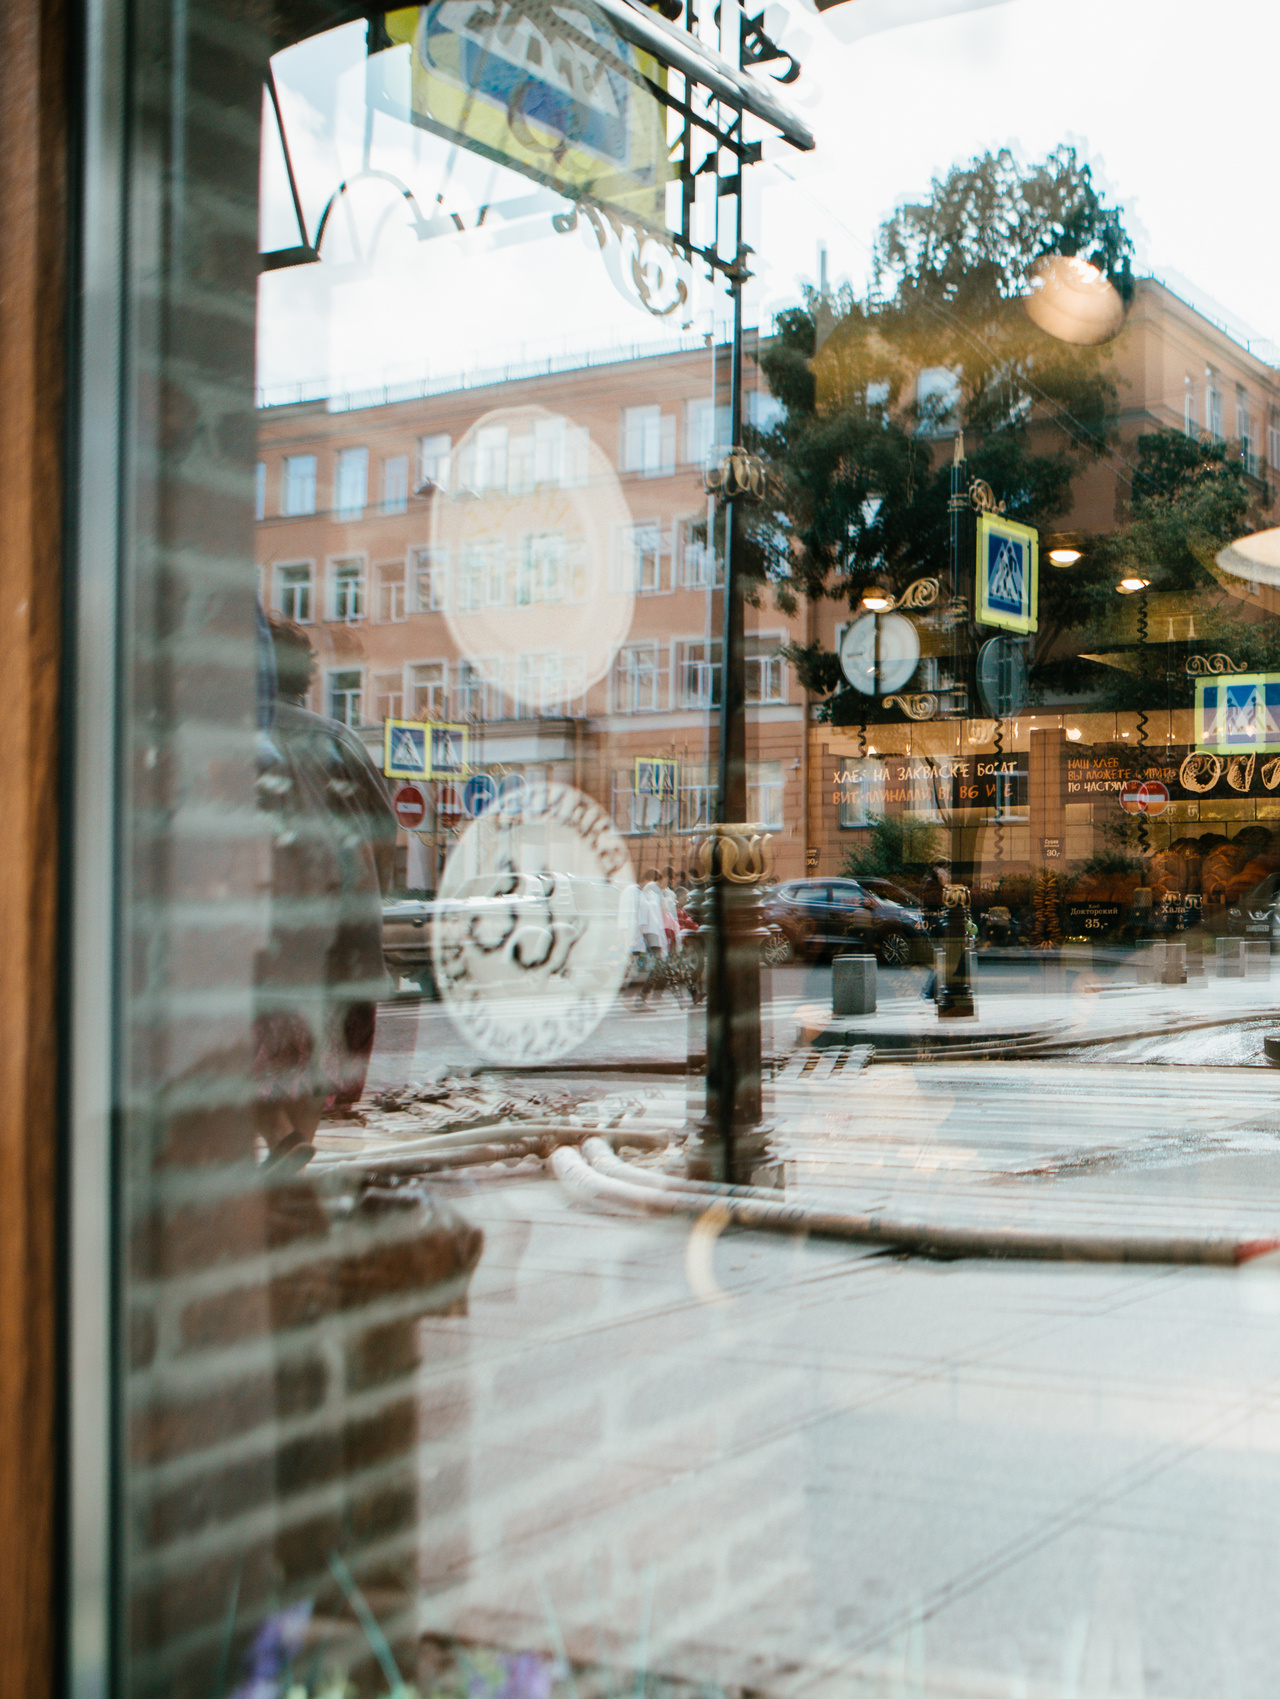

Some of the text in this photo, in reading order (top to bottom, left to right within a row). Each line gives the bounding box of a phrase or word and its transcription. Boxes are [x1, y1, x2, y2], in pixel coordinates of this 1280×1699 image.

[1068, 757, 1119, 769] НАШ ХЛЕБ
[873, 768, 891, 782] НА
[896, 763, 970, 781] ЗАКВАСКЕ
[1068, 770, 1082, 781] ВЫ
[1086, 769, 1131, 780] МОЖЕТЕ
[1068, 781, 1080, 792] ПО
[1084, 780, 1128, 792] ЧАСТЯМ
[1070, 908, 1118, 916] Докторский
[1161, 905, 1186, 914] Хала
